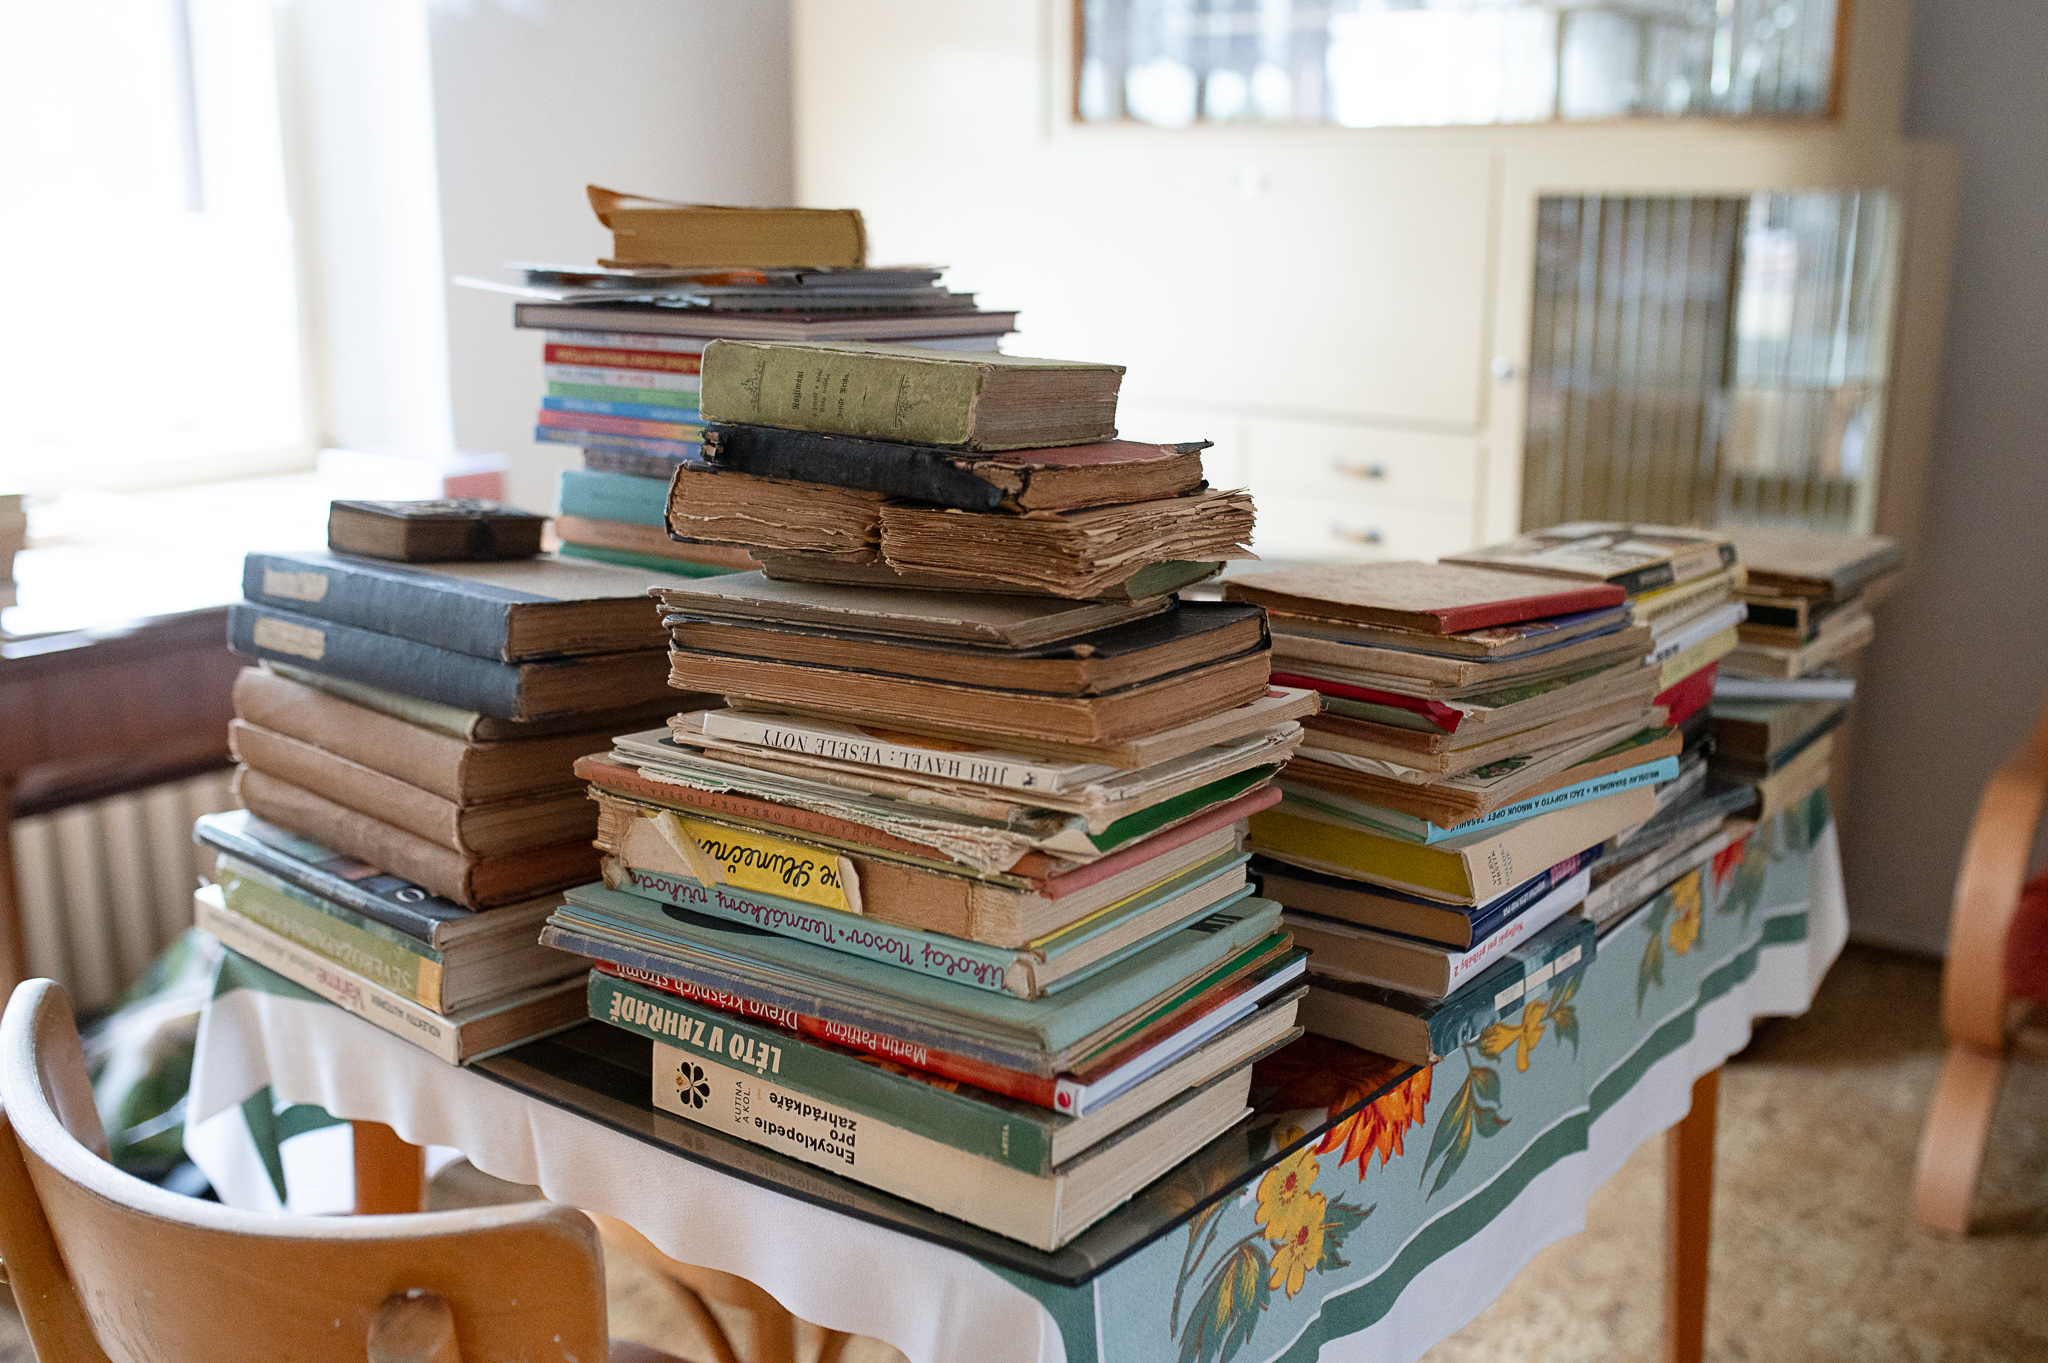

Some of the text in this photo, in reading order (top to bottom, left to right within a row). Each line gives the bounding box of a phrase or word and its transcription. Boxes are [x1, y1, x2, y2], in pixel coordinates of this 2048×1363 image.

[760, 730, 808, 752] NOTY
[845, 929, 914, 966] Nosov
[1453, 966, 1459, 977] 2
[750, 1001, 798, 1031] Dřevo
[608, 991, 782, 1075] LÉTO V ZAHRADĚ
[824, 1020, 877, 1051] Patřičný
[882, 1037, 927, 1066] Martin
[734, 1081, 743, 1123] KUTINA
[742, 1088, 751, 1124] A KOL.
[769, 1092, 858, 1132] zahrádkáře
[754, 1117, 856, 1166] Encyklopedie
[829, 1129, 856, 1149] pro
